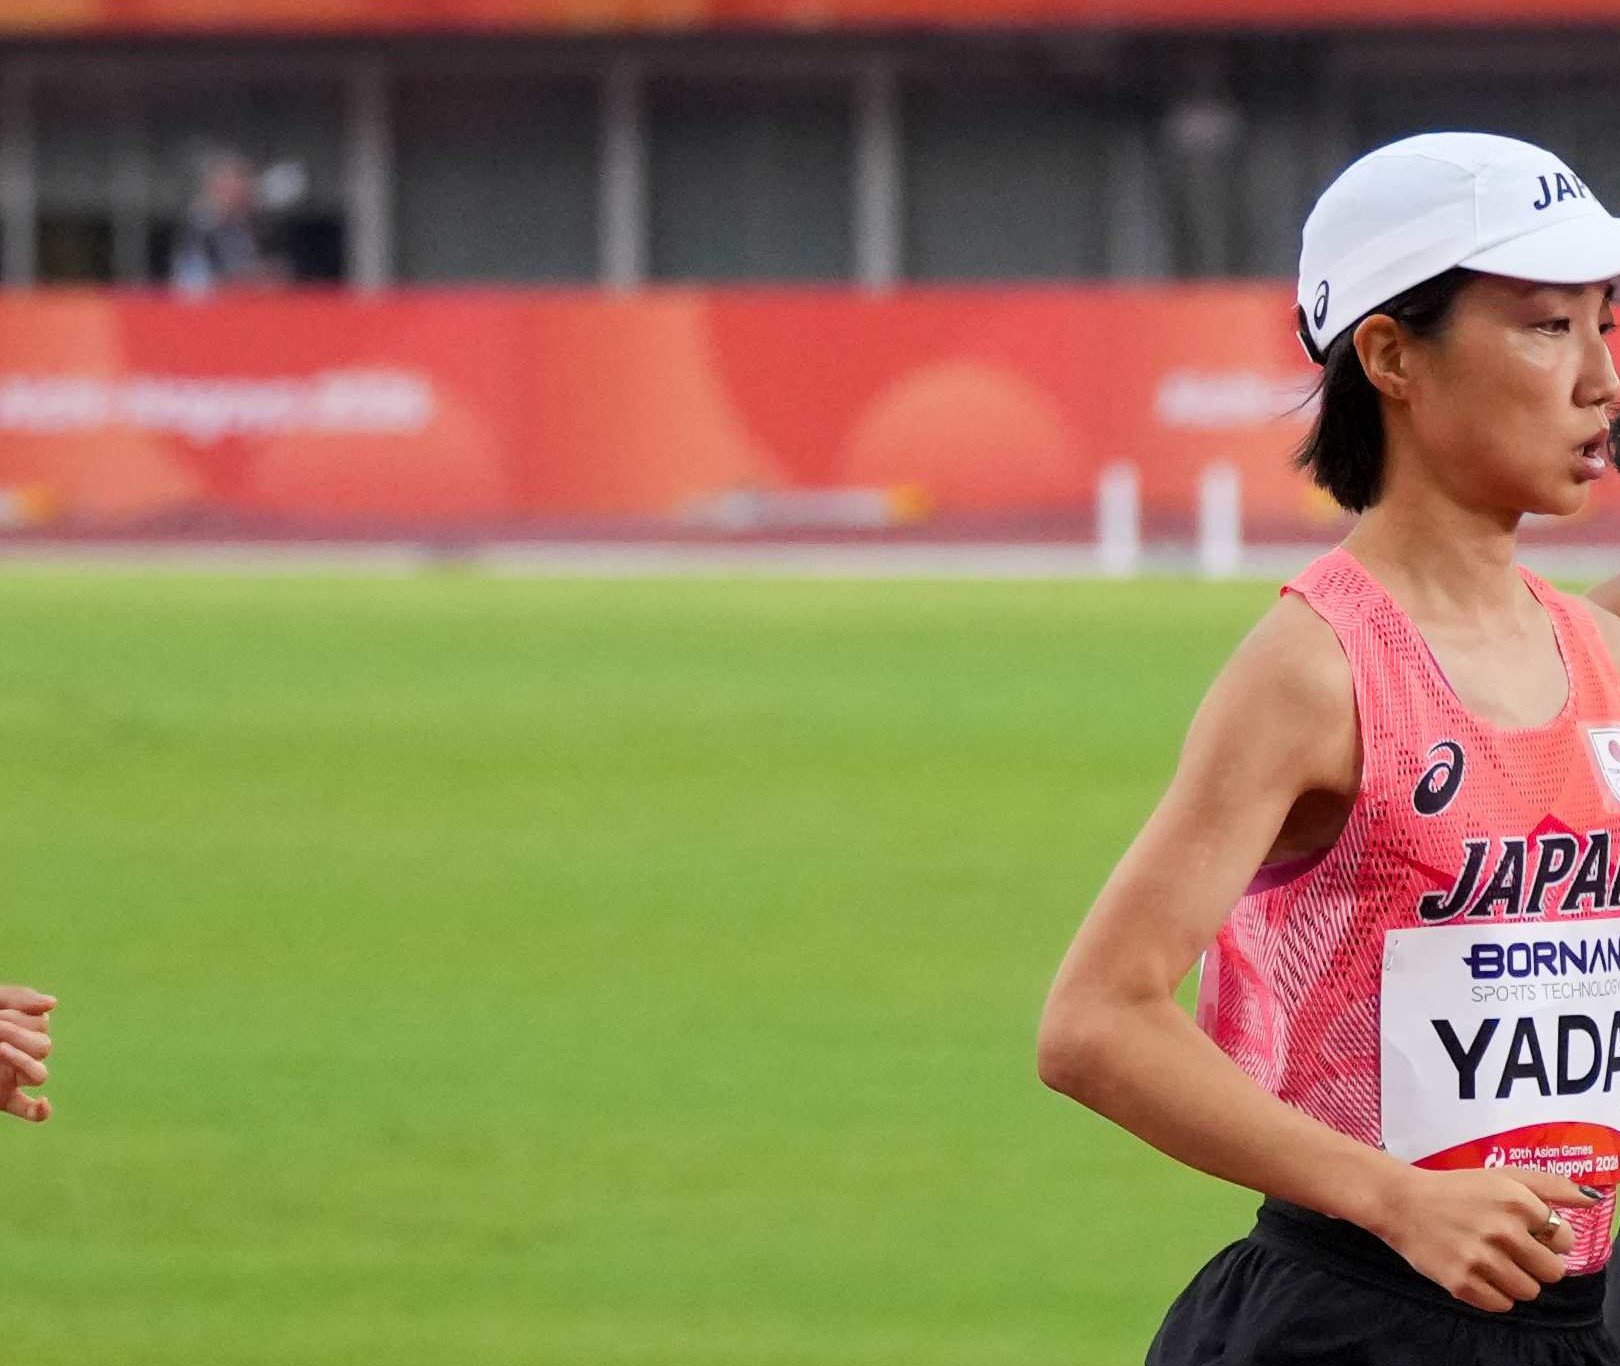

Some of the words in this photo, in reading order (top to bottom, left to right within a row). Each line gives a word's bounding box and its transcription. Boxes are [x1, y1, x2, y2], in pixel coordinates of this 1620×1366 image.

[1471, 983, 1537, 1003] SPORTS
[1509, 1148, 1533, 1160] 20th
[1534, 1147, 1560, 1159] Asian
[1561, 1144, 1594, 1157] Games
